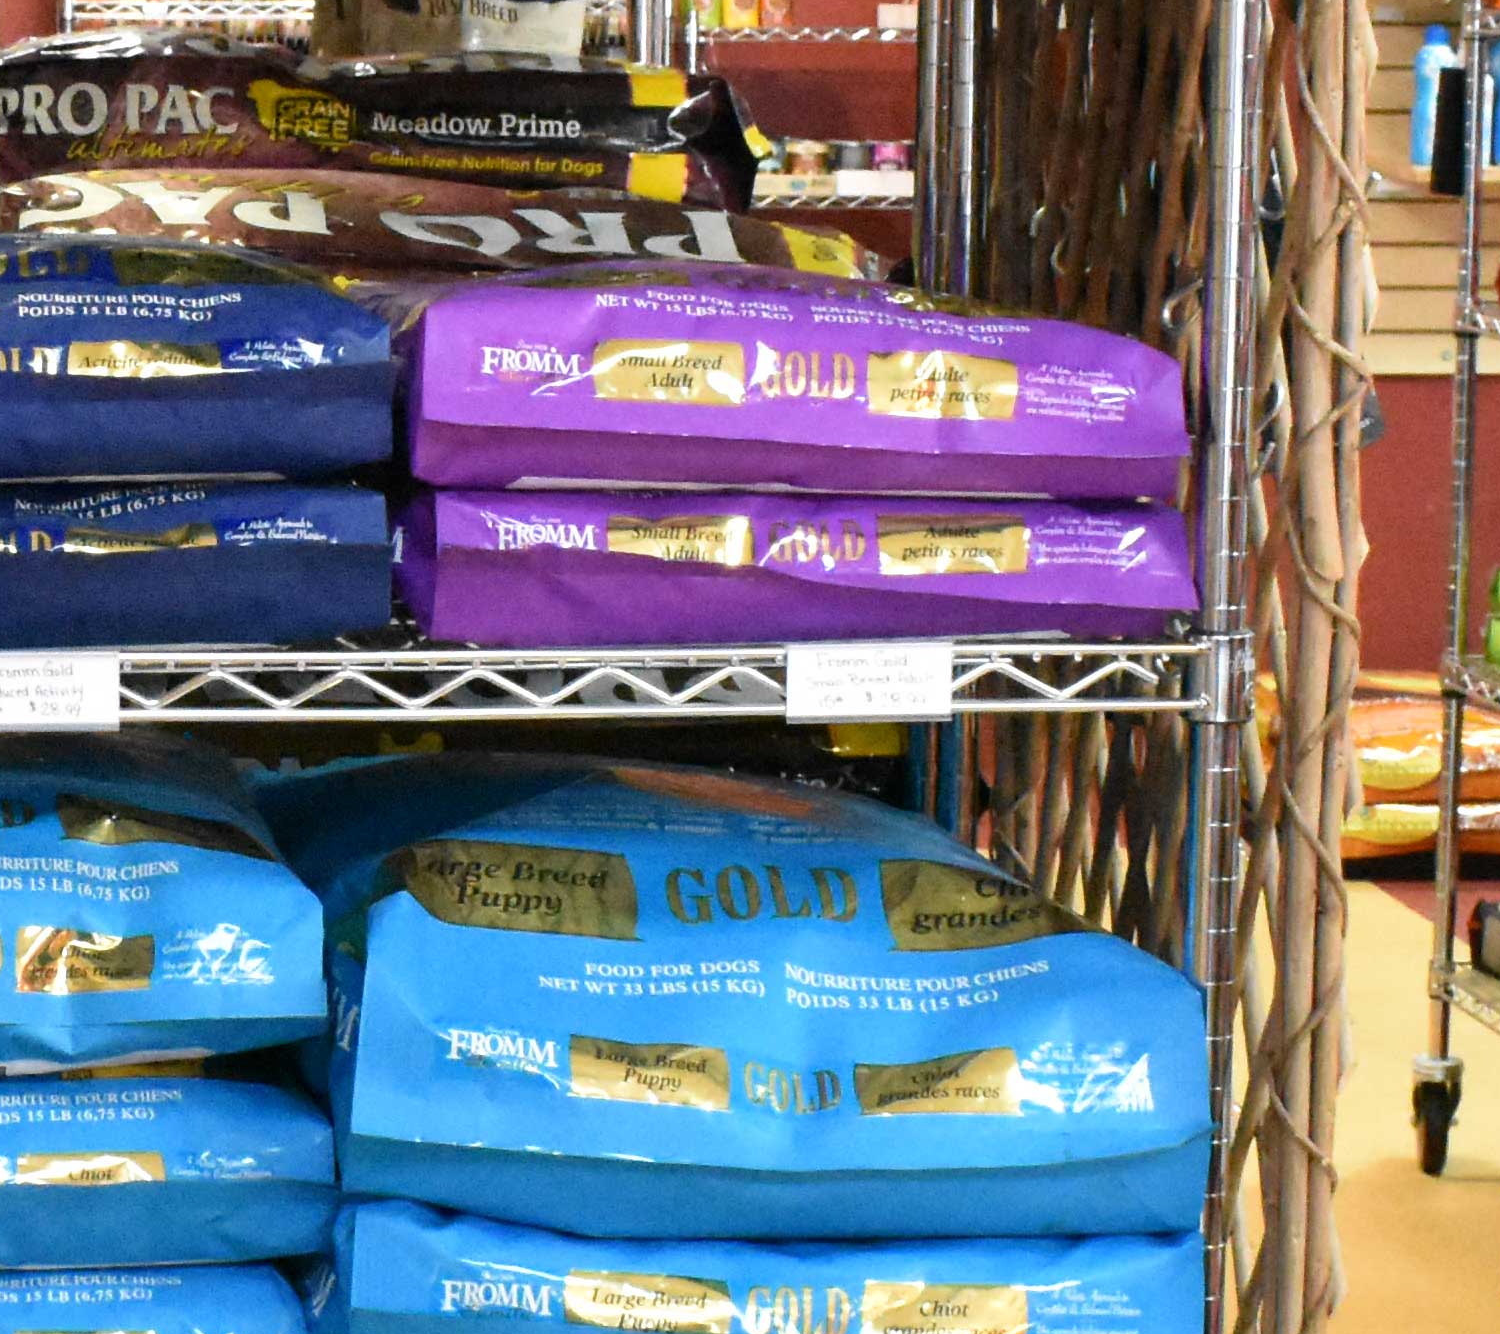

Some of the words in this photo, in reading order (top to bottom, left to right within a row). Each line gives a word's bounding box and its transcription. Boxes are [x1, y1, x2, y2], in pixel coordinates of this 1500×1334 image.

[125, 82, 240, 136] PAC
[275, 99, 350, 119] GRAIN
[271, 117, 351, 140] FREE
[371, 111, 492, 139] Meadow
[498, 114, 582, 140] Prime
[462, 153, 528, 172] Nutrition
[560, 157, 605, 176] Dogs
[20, 175, 334, 235] PAC
[378, 207, 752, 268] PRO
[480, 345, 581, 378] FROMM
[497, 522, 597, 551] FROMM
[632, 525, 683, 543] Small
[43, 660, 73, 676] Gold
[456, 882, 562, 917] Puppy
[584, 962, 645, 977] FOOD
[650, 961, 688, 976] FOR
[693, 959, 761, 976] DOGS
[622, 1068, 683, 1094] Puppy
[954, 1084, 1001, 1102] races
[441, 1280, 552, 1317] FROMM
[591, 1289, 648, 1310] Large
[916, 1298, 970, 1320] Chiot
